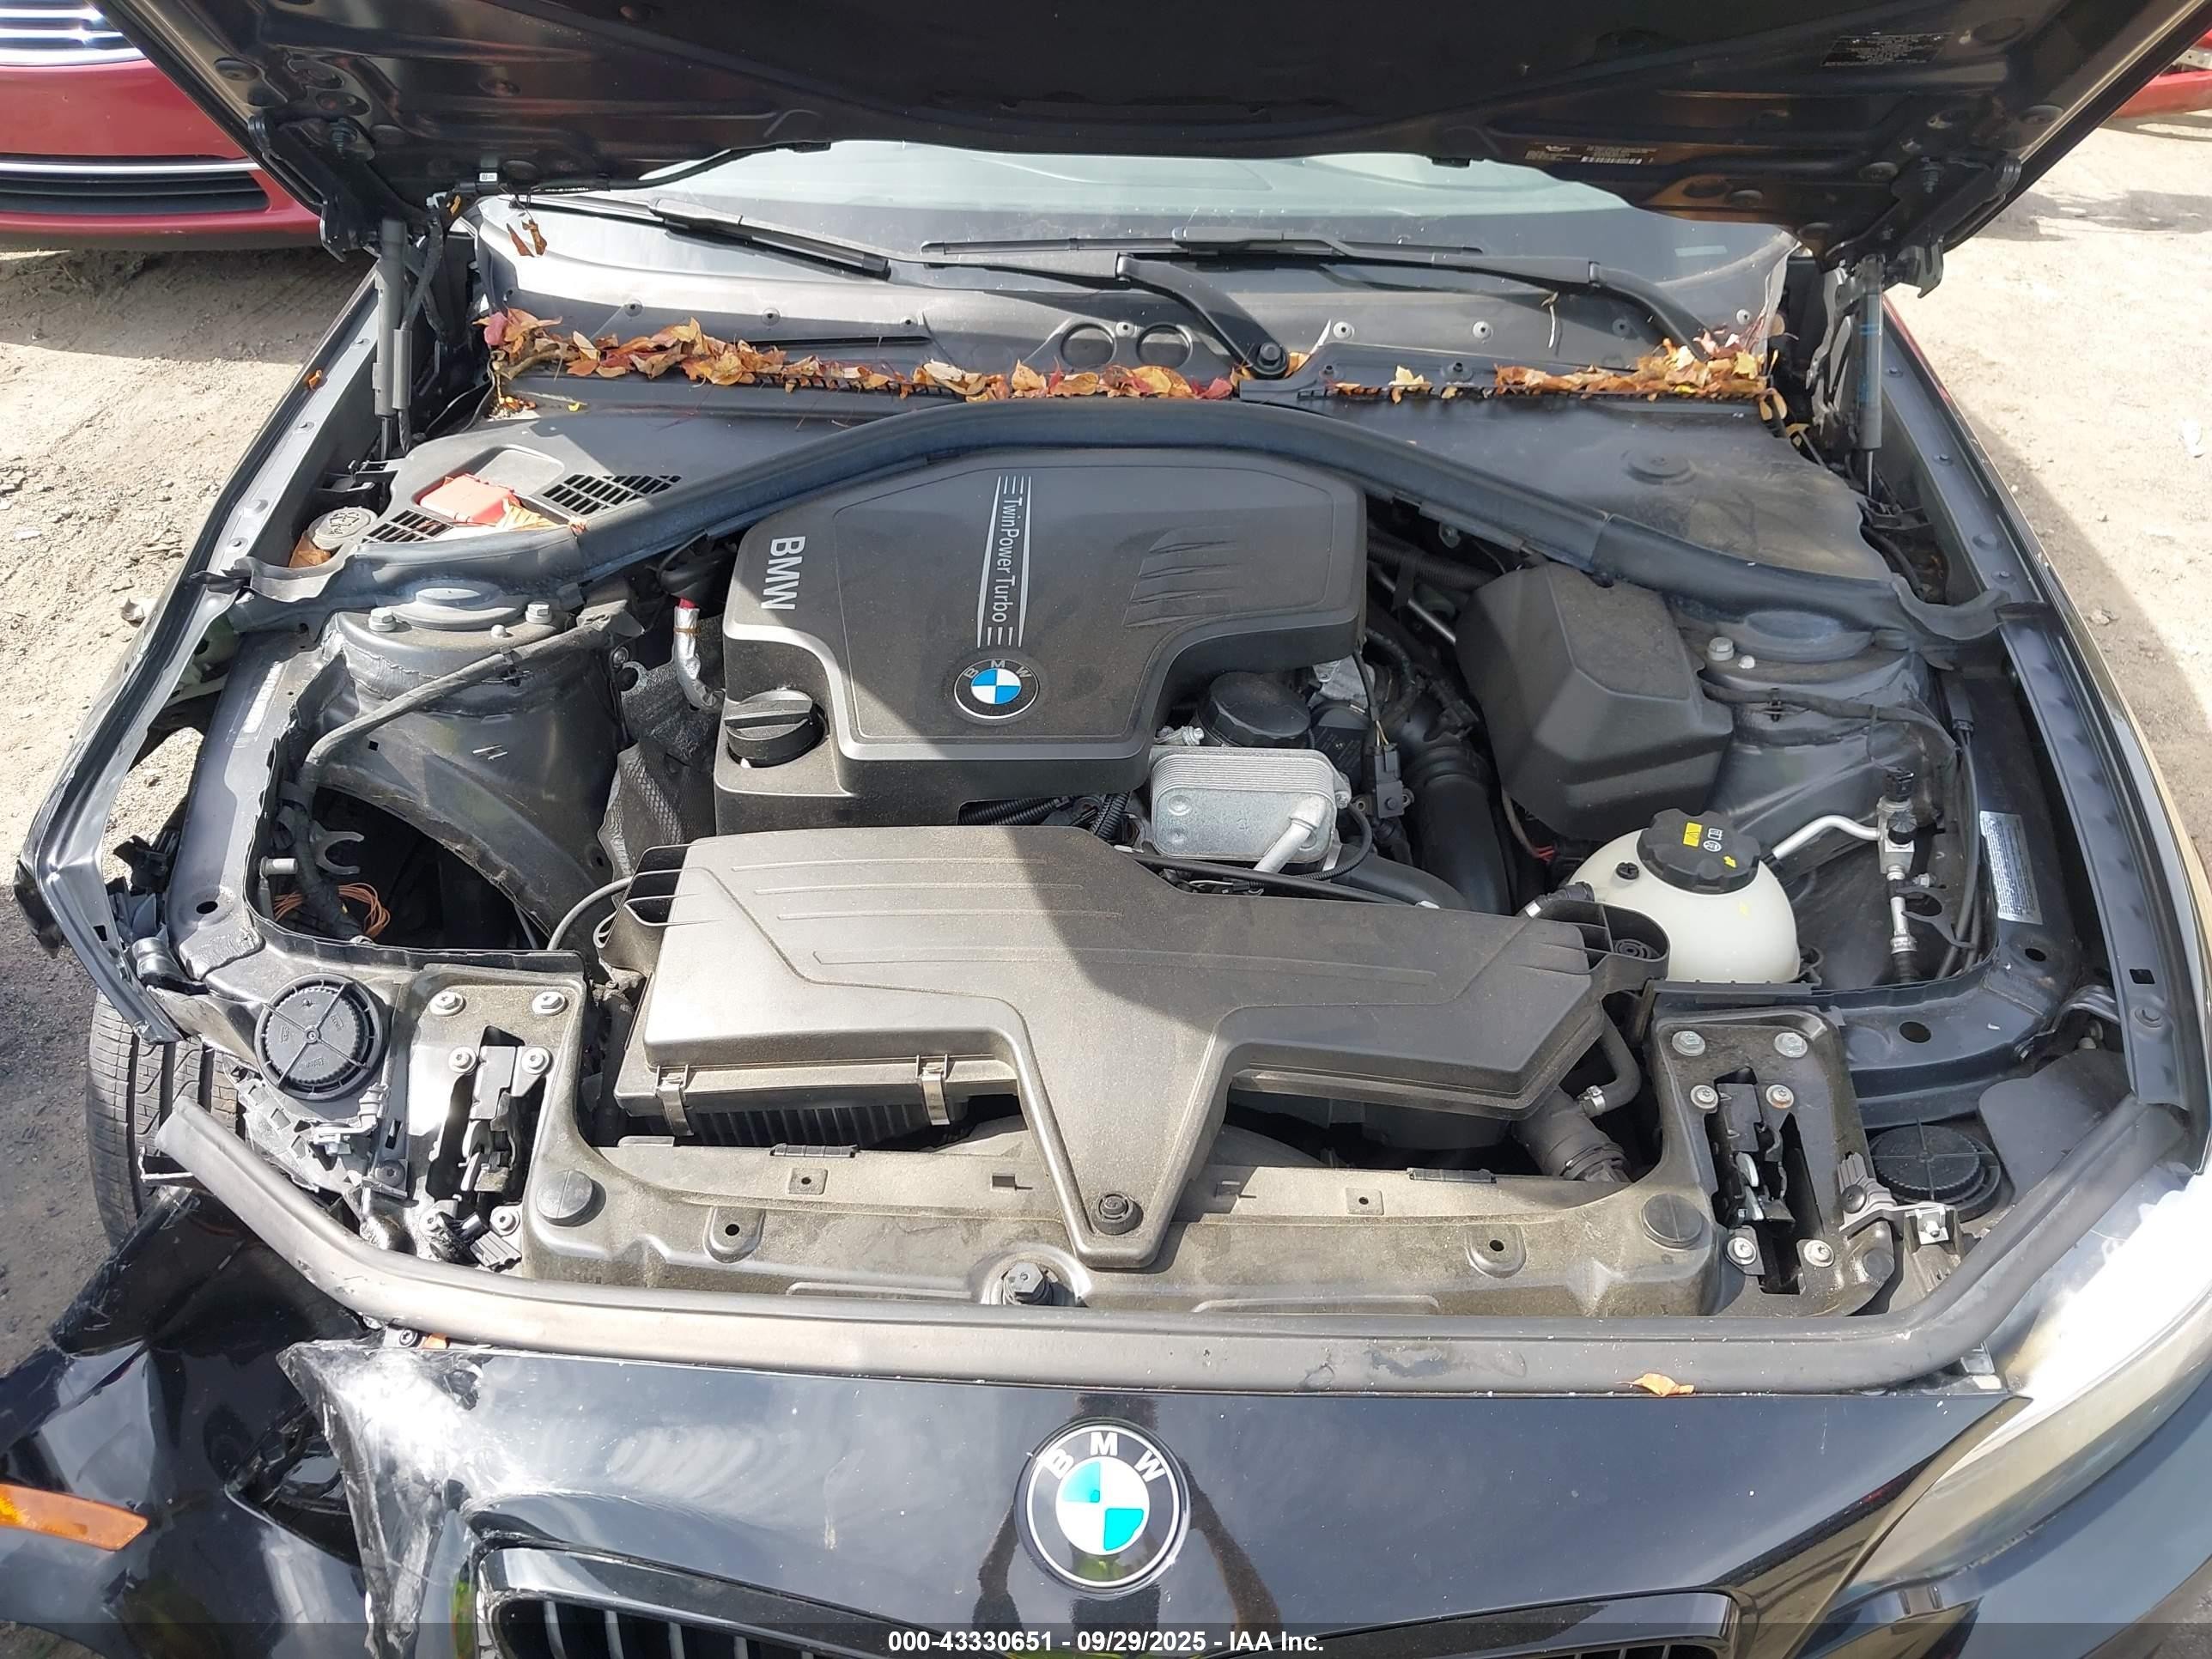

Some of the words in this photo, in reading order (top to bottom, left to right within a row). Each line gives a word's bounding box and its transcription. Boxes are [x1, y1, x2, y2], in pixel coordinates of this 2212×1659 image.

[997, 496, 1023, 574] TwinPower
[761, 536, 805, 610] BMW
[991, 574, 1016, 623] Turbo
[963, 659, 1031, 678] BMW
[1037, 1431, 1166, 1483] BMW
